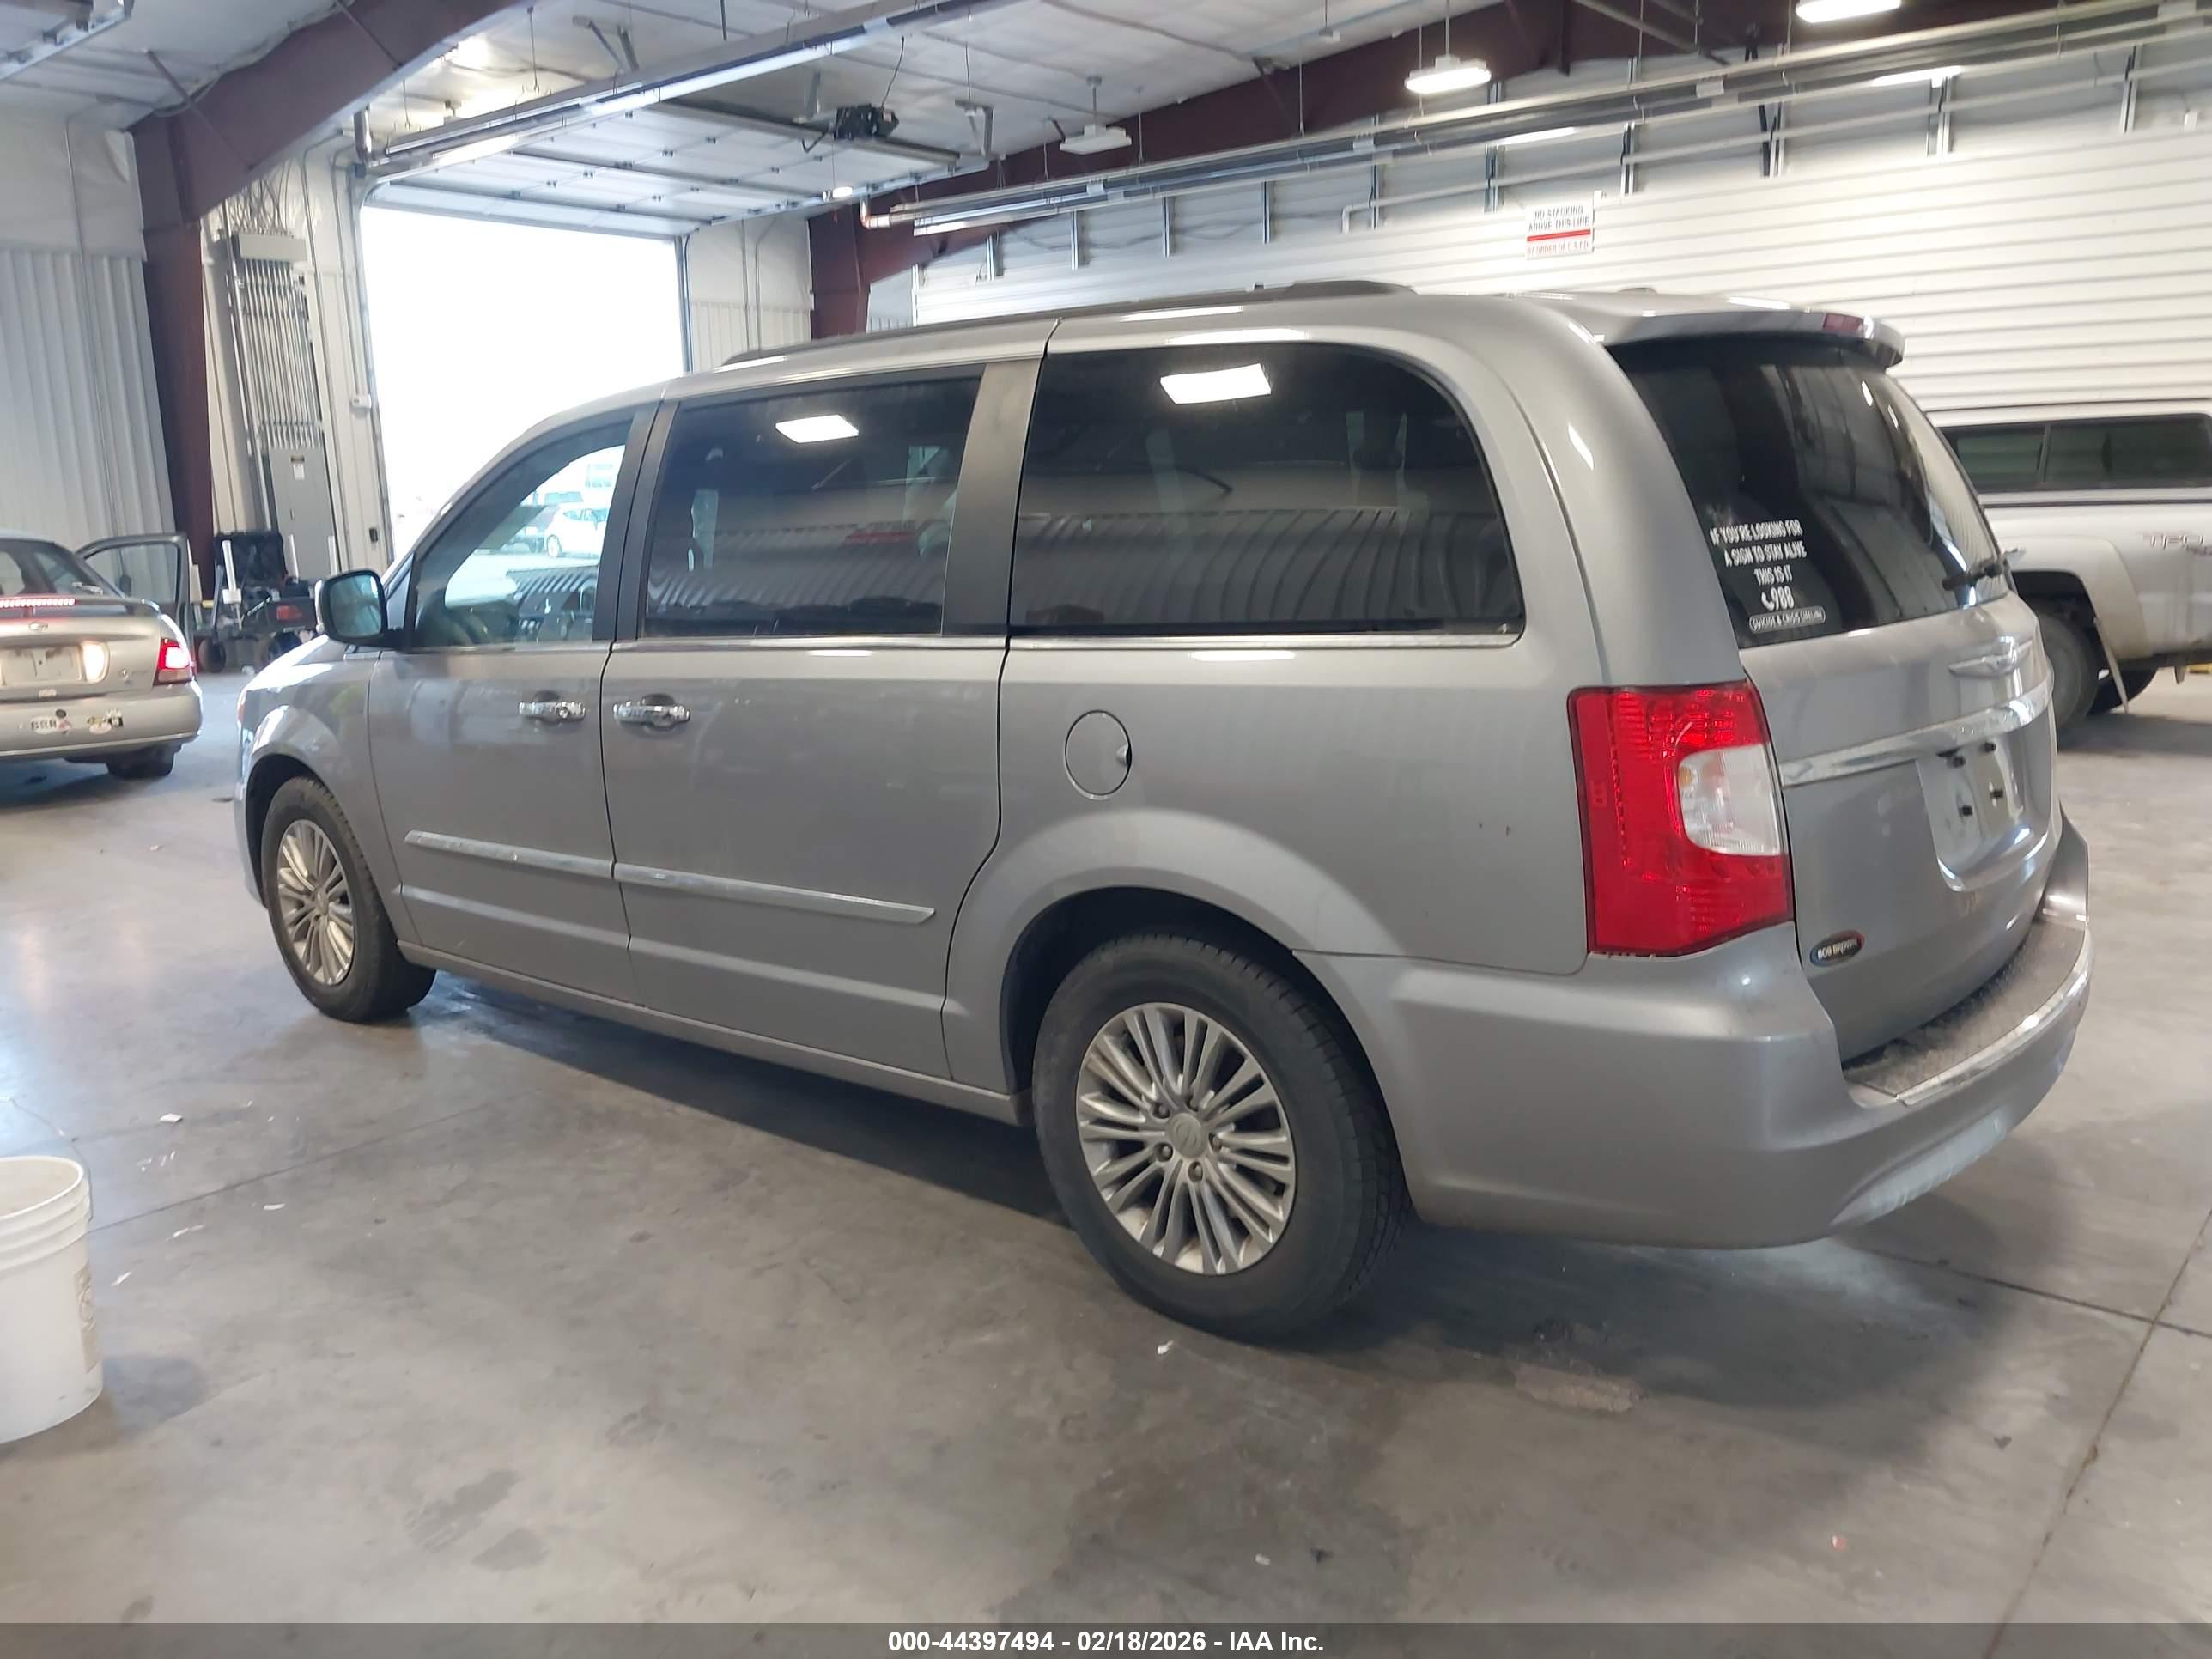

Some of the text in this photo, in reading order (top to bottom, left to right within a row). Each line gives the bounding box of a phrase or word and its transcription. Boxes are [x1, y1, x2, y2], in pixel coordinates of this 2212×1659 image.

[1710, 519, 1803, 546] IF YOU'RE LOOKING FOR
[1723, 540, 1808, 567] A SIGN TO STAY ALIVE
[1753, 564, 1793, 586] THIS IS IT
[1771, 586, 1796, 611] 988
